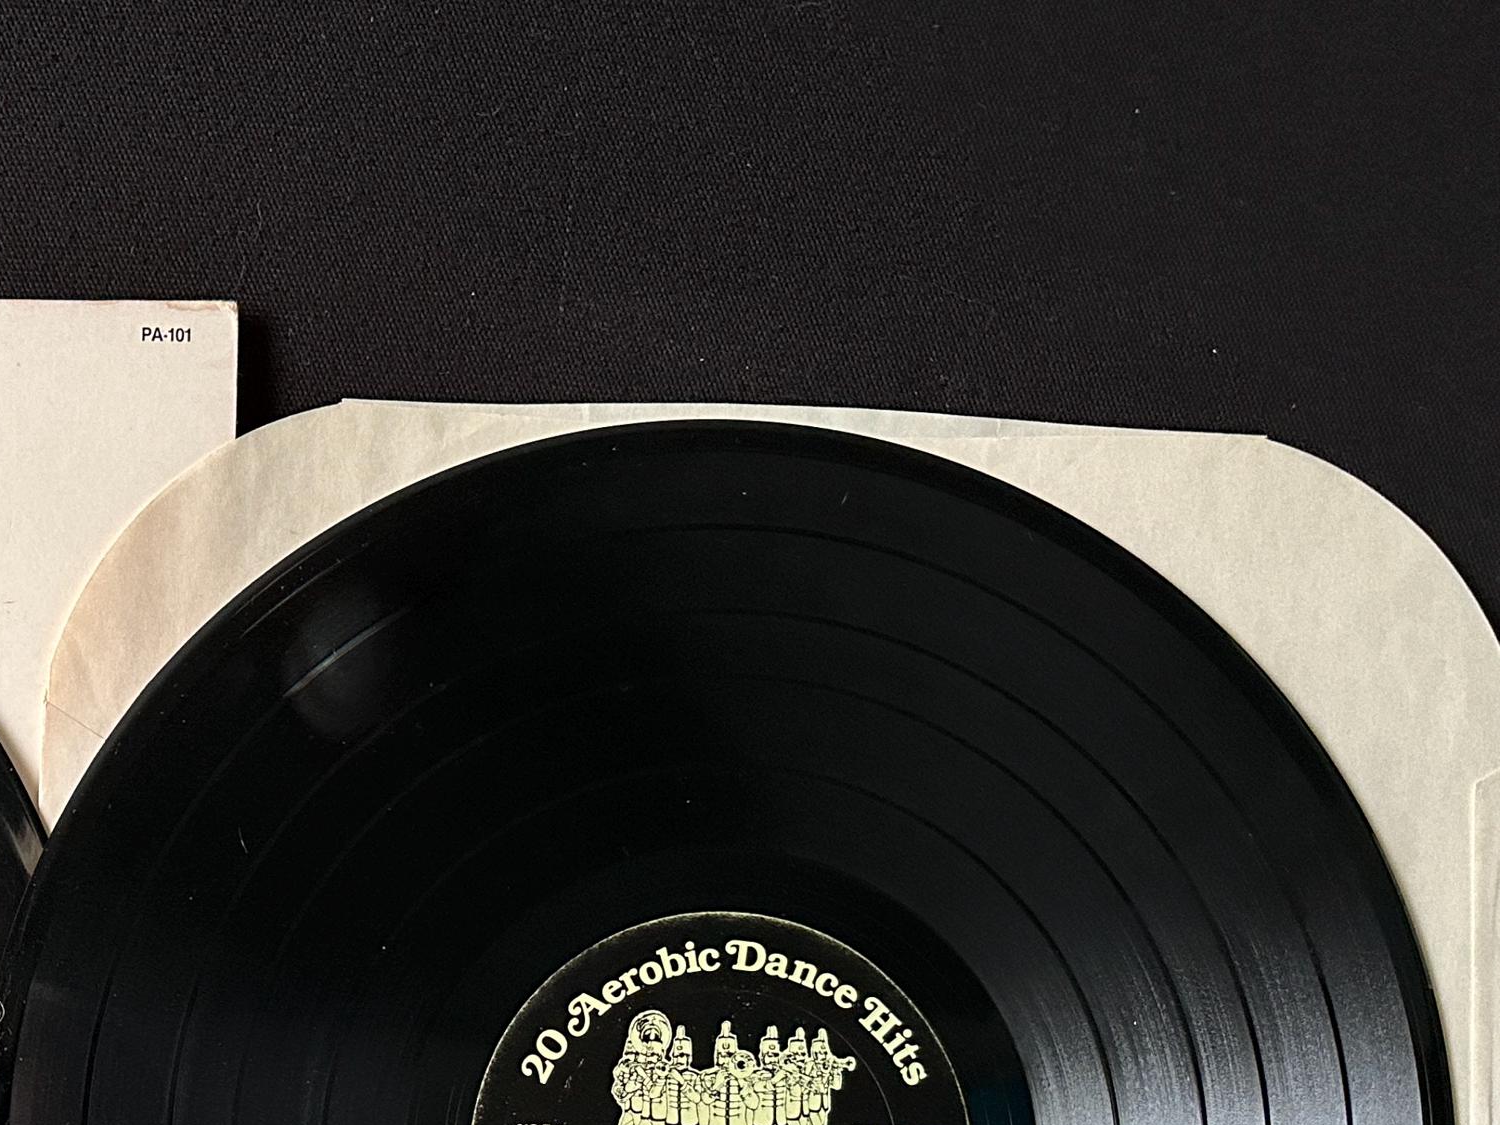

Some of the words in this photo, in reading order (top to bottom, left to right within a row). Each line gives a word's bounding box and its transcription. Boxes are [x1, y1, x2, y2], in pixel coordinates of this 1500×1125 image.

[141, 327, 191, 342] PA-101
[521, 1028, 569, 1085] 20
[567, 941, 721, 1038] Aerobic
[725, 940, 858, 1008] Dance
[858, 996, 928, 1087] Hits
